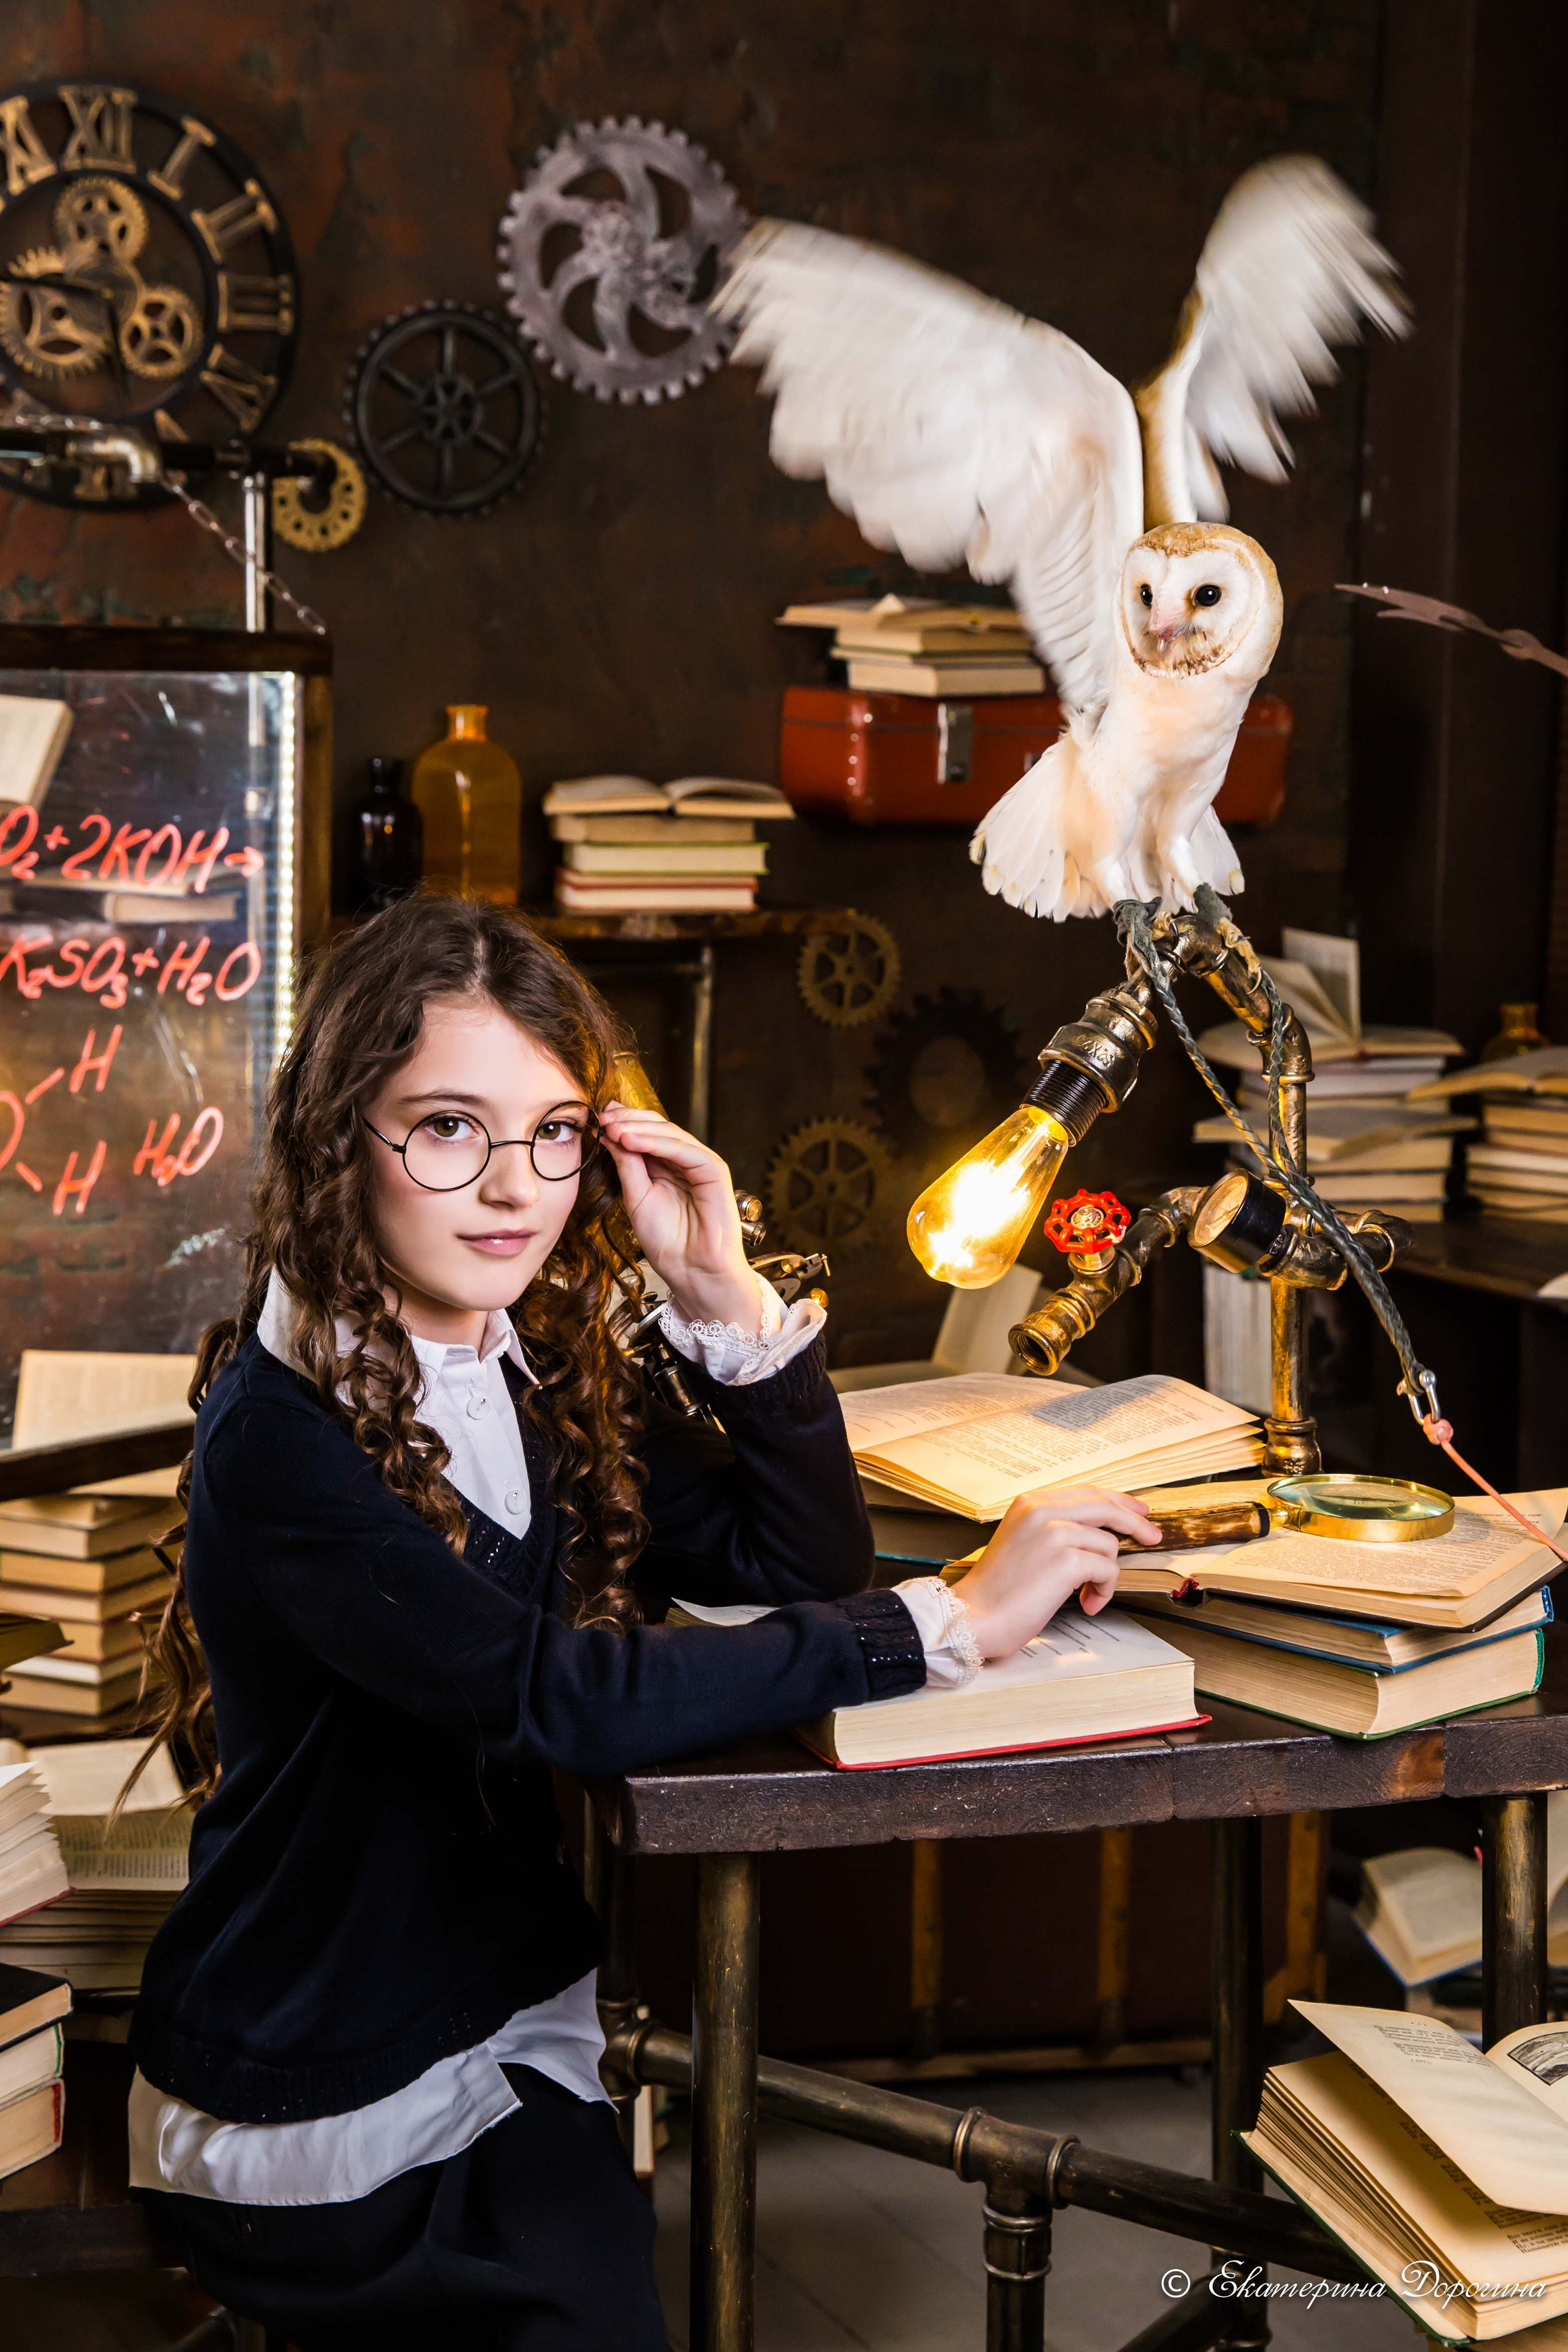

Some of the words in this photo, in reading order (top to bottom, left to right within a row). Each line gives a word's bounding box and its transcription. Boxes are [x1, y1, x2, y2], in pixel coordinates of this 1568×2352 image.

[58, 85, 138, 174] XII
[69, 1024, 123, 1093] H
[52, 1140, 107, 1216] H
